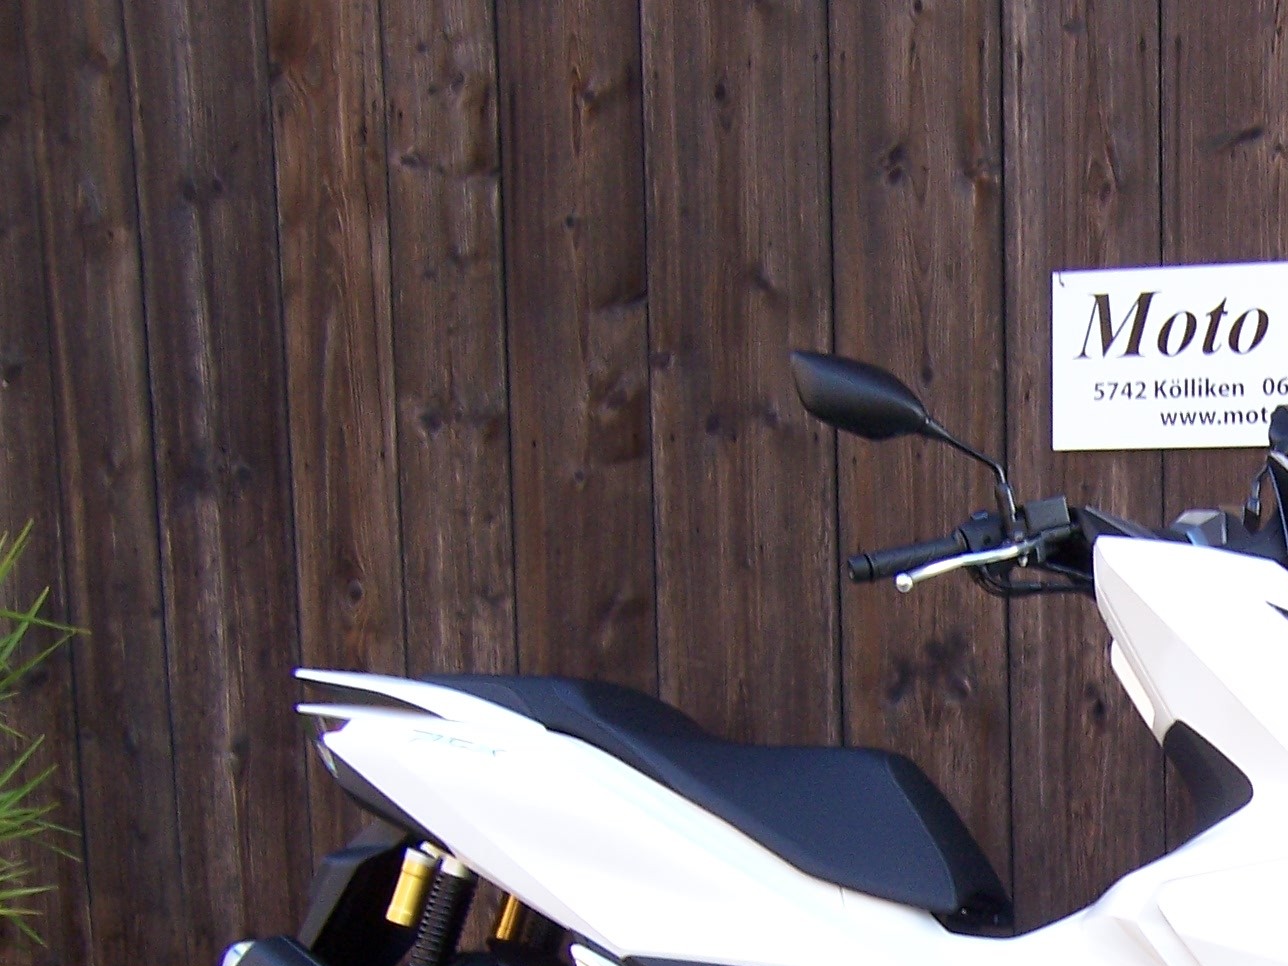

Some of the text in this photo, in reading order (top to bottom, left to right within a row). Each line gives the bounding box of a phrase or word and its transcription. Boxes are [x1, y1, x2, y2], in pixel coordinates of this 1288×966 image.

[1073, 290, 1269, 360] Moto
[1093, 381, 1147, 401] 5742
[1154, 376, 1245, 400] Kölliken
